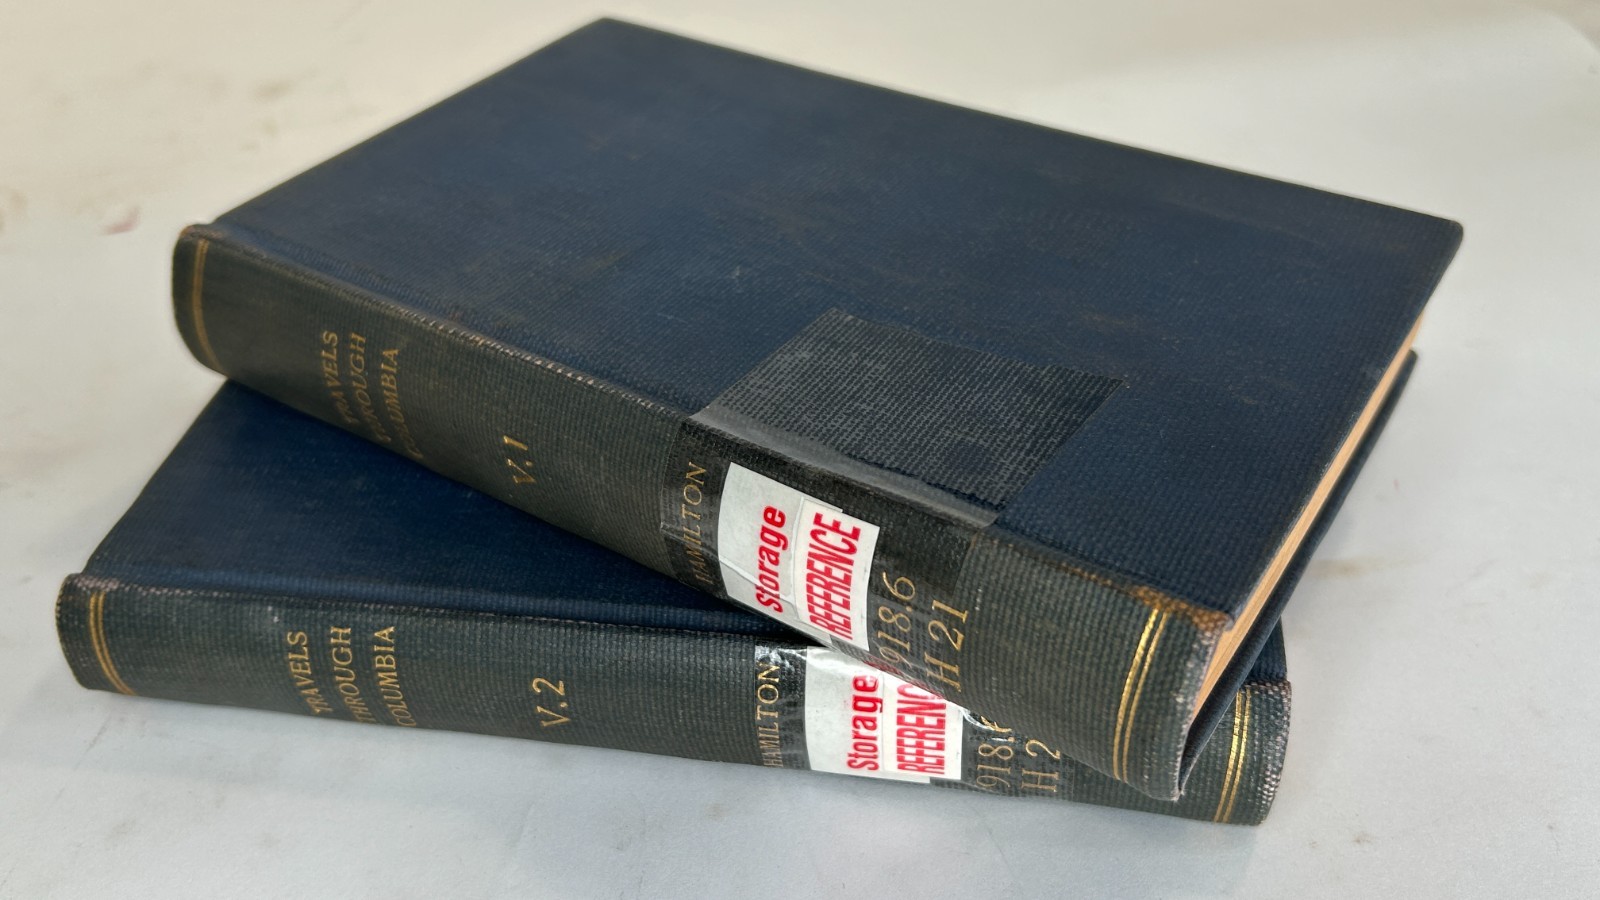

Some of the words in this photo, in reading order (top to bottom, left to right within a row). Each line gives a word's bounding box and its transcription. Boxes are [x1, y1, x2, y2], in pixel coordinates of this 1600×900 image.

[681, 461, 714, 585] HAMILTON
[755, 505, 789, 613] Storage
[805, 511, 862, 641] REFERENCE
[877, 571, 915, 668] 918.6
[287, 630, 332, 714] TRAVELS
[330, 626, 376, 724] THROUGH
[373, 625, 417, 727] COLUMBIA
[532, 676, 571, 727] V.2
[757, 661, 784, 768] HAMILTON
[847, 674, 883, 771] Storage
[896, 683, 947, 775] REFERENC
[1025, 738, 1061, 761] 2
